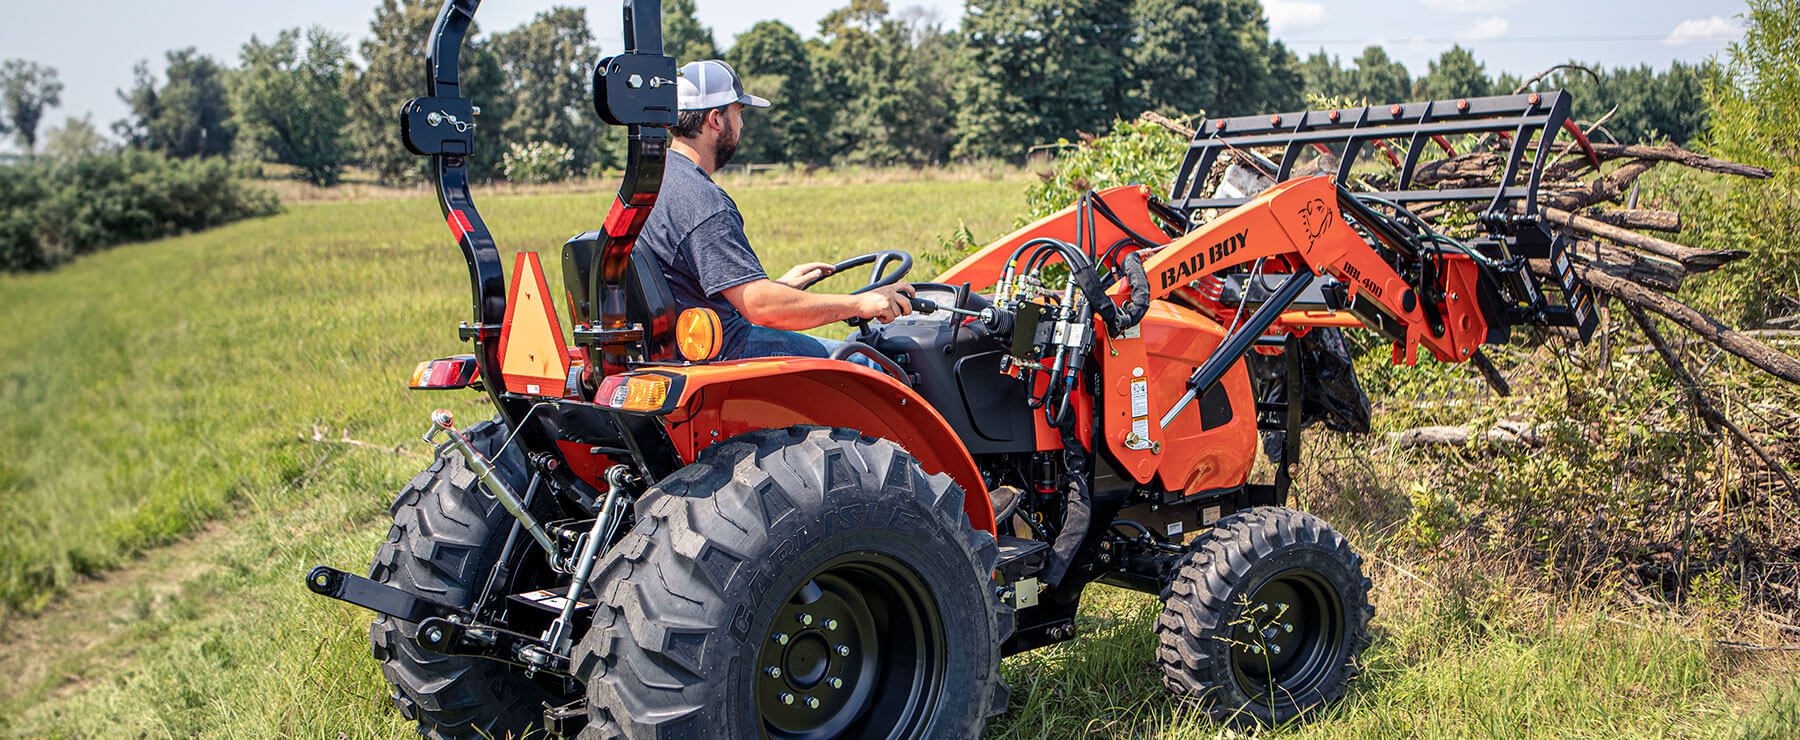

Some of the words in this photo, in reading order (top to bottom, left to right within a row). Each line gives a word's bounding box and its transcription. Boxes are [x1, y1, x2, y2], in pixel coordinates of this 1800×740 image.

[1161, 252, 1205, 290] BAD
[1209, 228, 1248, 264] BOY
[1362, 278, 1383, 298] 400
[728, 502, 919, 644] CARLISLE
